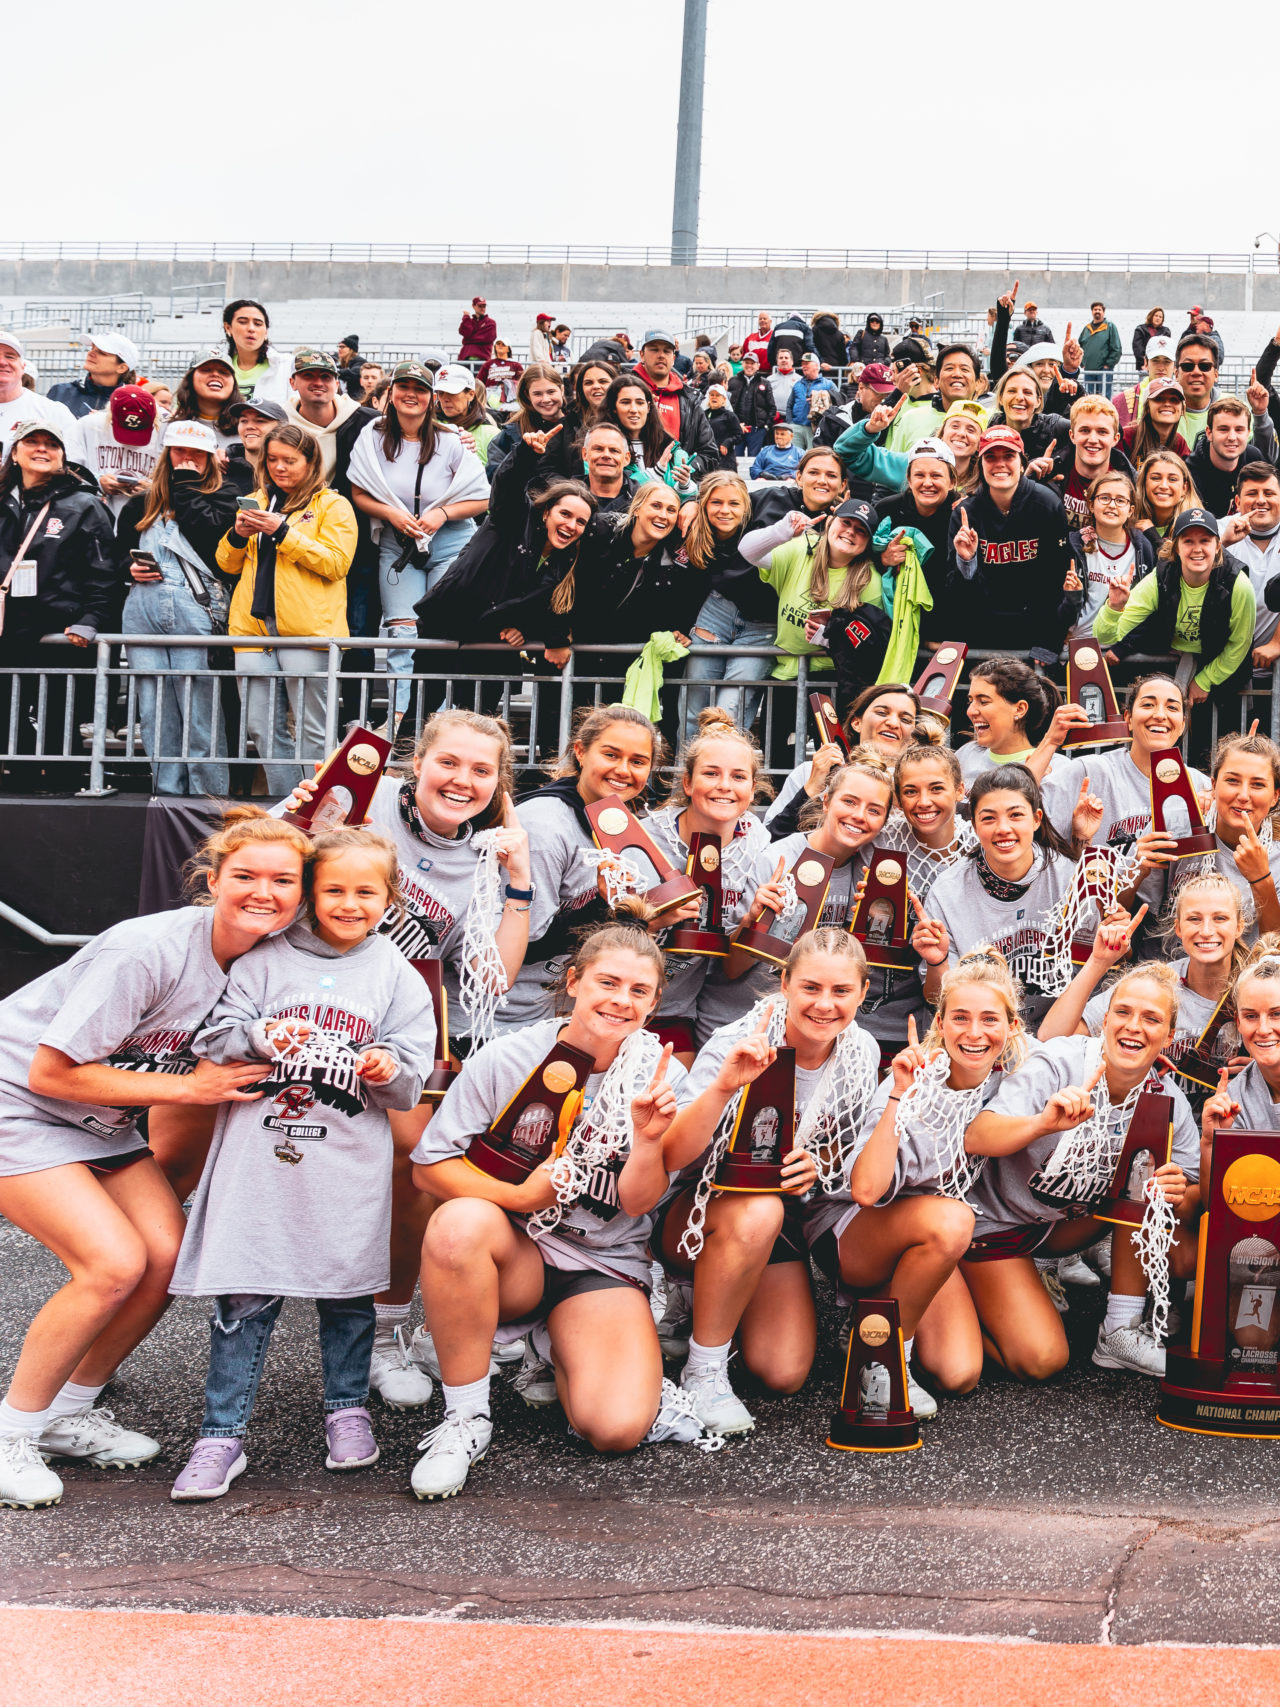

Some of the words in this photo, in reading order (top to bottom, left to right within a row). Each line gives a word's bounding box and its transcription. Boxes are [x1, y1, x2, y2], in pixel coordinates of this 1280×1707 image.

[782, 603, 808, 620] LACR
[349, 753, 377, 770] NCAA
[876, 869, 901, 881] NCAA
[374, 903, 433, 960] PIONS
[1014, 928, 1047, 951] LACRO
[314, 1005, 377, 1044] LACROS
[290, 1126, 323, 1137] COLLEGE
[1026, 1169, 1108, 1205] CHAMP
[1237, 1256, 1273, 1266] DIVISION
[861, 1329, 889, 1339] NCAA
[1241, 1350, 1279, 1360] LACROSSE
[1196, 1404, 1243, 1420] NATIONAL
